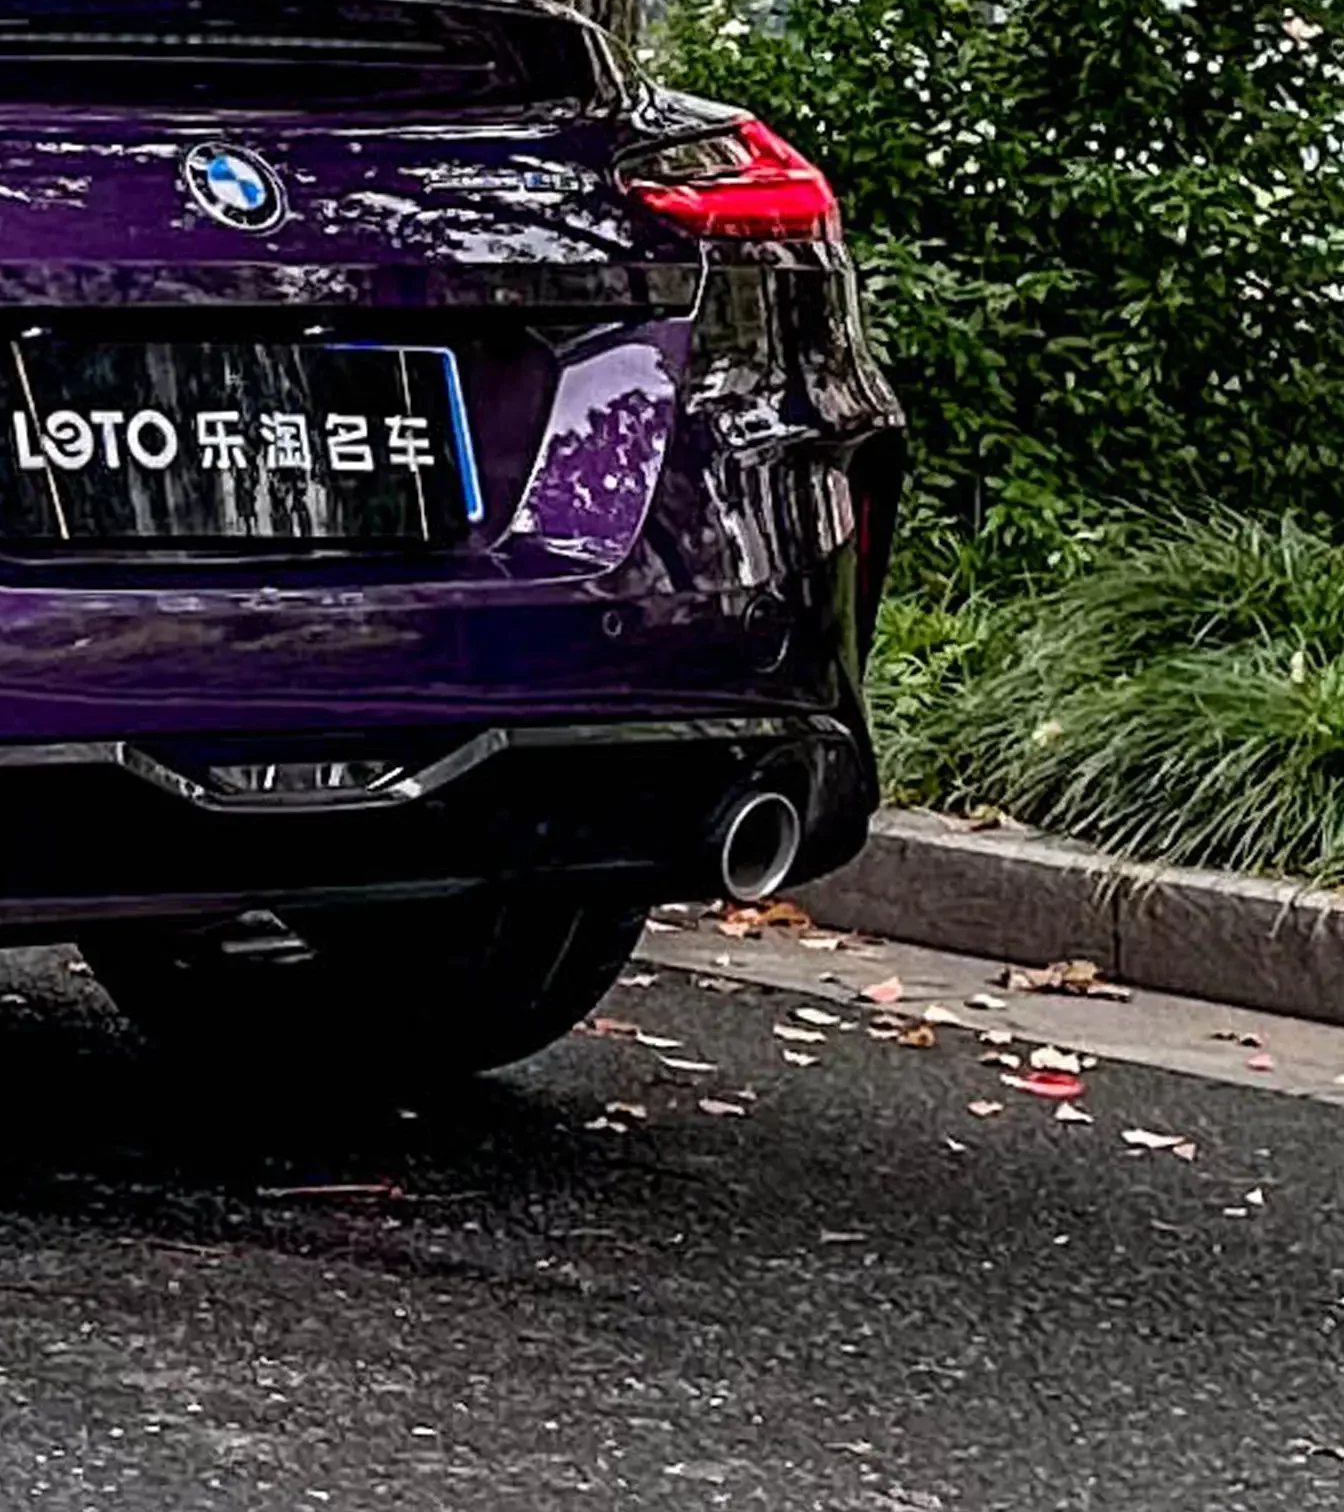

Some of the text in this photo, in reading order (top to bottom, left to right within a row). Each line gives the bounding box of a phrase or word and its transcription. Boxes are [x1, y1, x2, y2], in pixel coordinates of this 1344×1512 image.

[13, 409, 178, 471] LOTO
[197, 410, 434, 472] 乐淘名车
